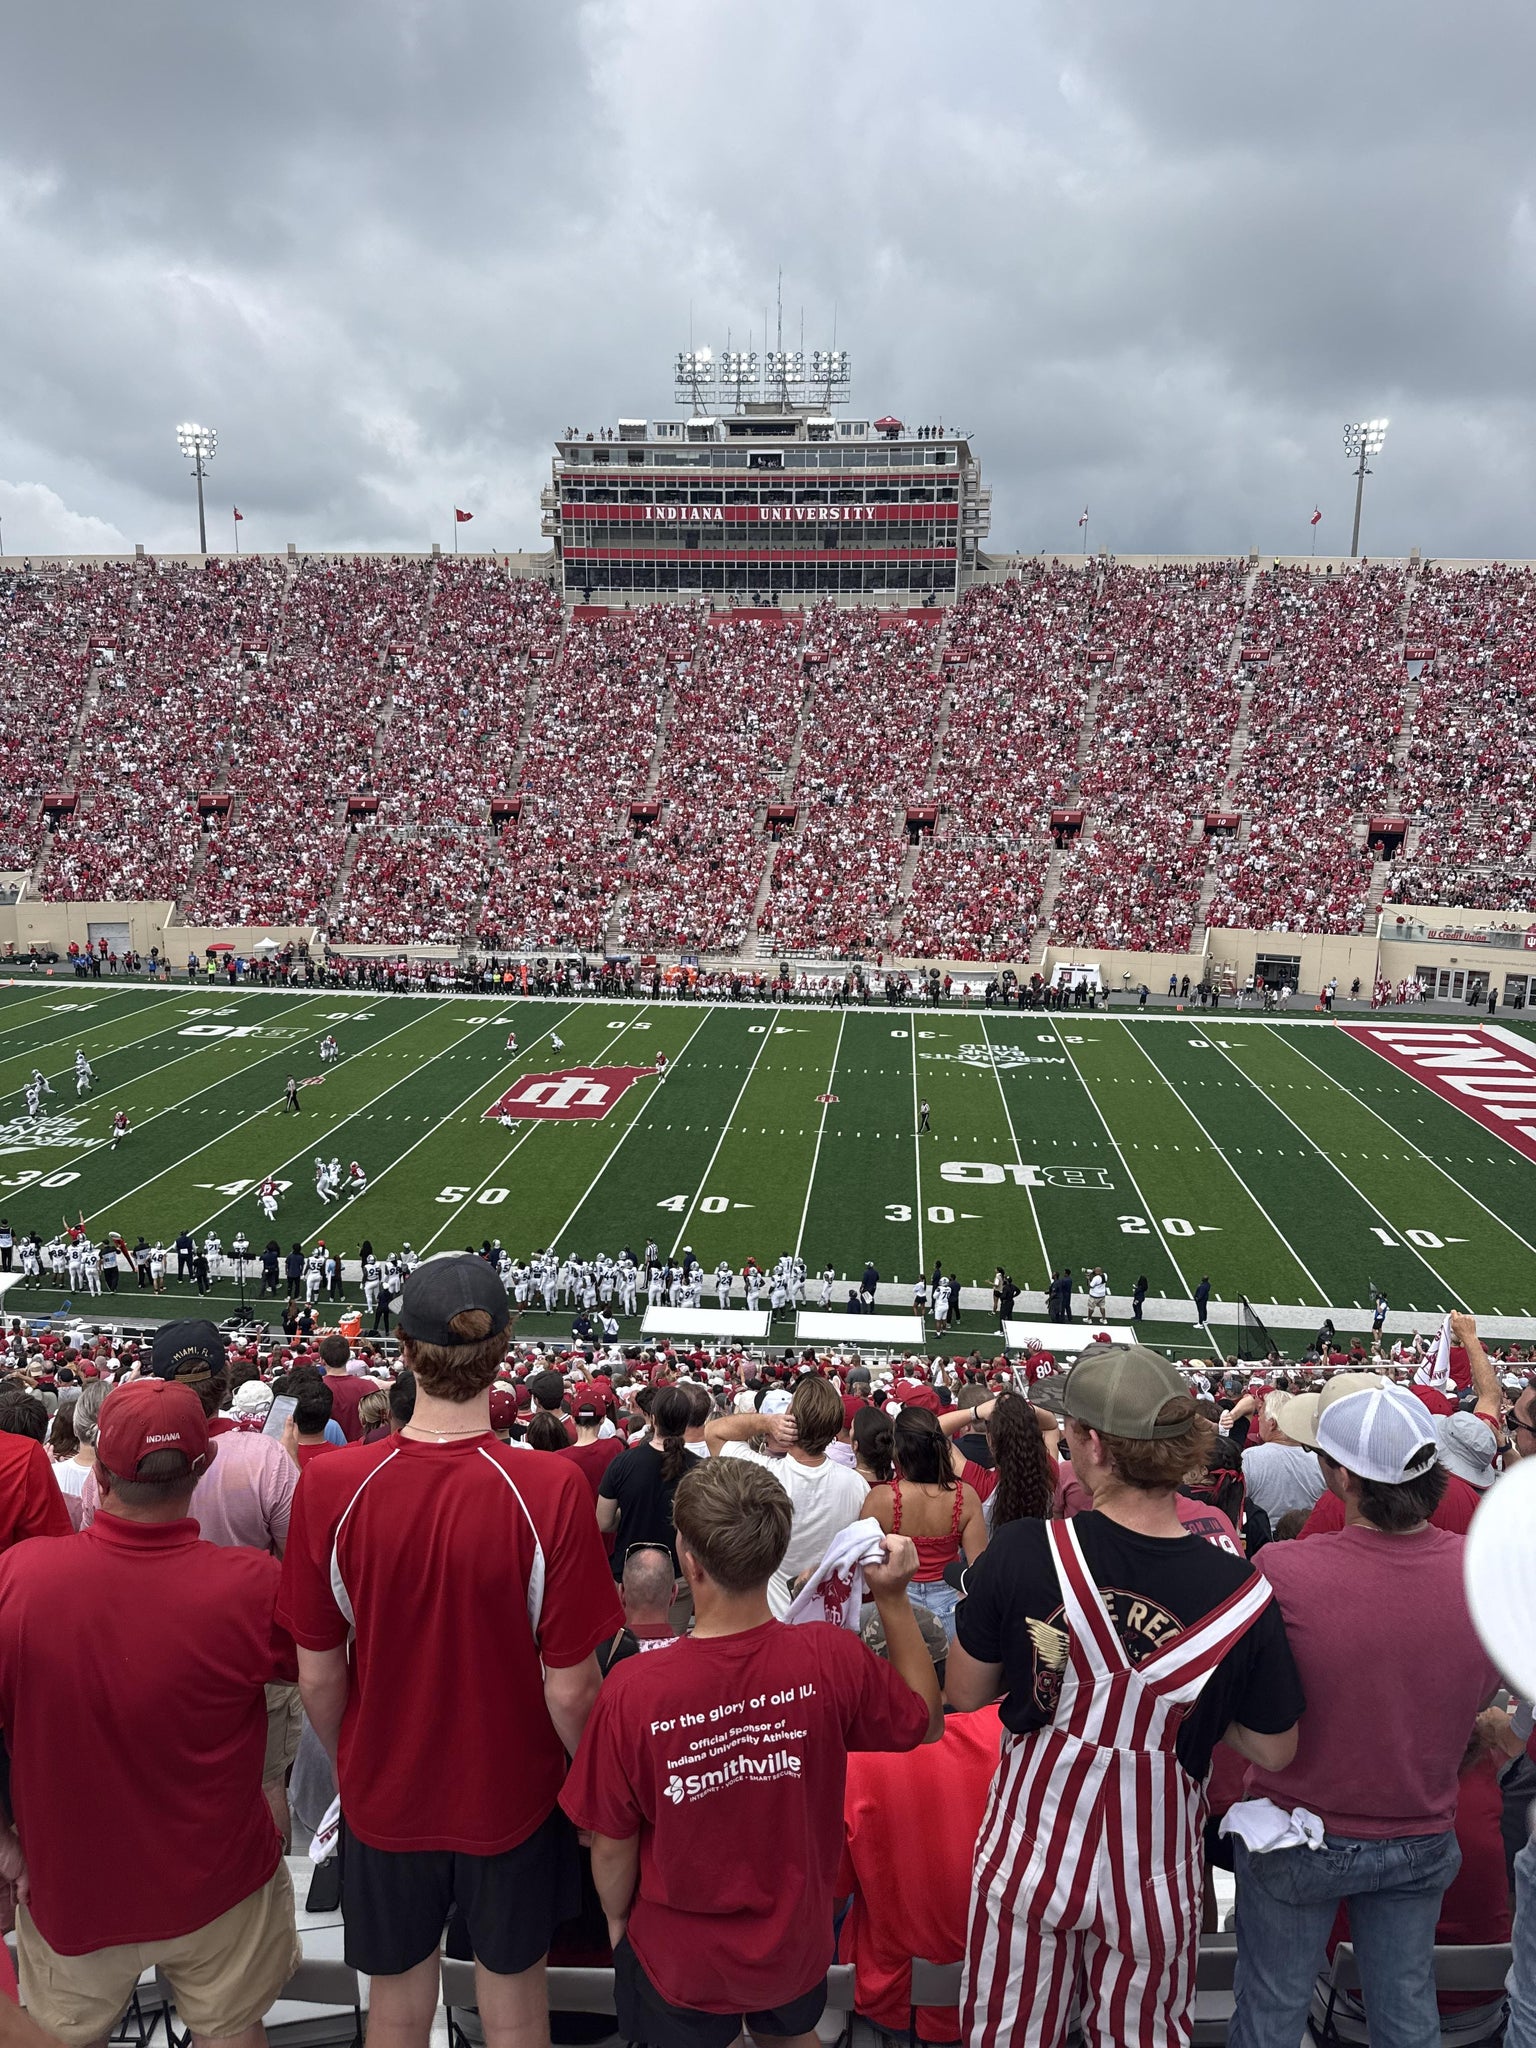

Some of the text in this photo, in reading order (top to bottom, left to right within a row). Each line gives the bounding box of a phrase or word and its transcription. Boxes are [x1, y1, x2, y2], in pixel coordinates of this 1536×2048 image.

[646, 507, 875, 520] INDIANA UNIVERSITY
[1438, 930, 1462, 940] Credit
[1464, 932, 1487, 941] Union
[0, 1170, 81, 1187] 30
[434, 1186, 510, 1205] 50
[656, 1194, 730, 1213] 40
[885, 1204, 955, 1224] 30
[1116, 1215, 1196, 1237] 20
[1369, 1226, 1445, 1249] 10
[1036, 1361, 1052, 1379] 80
[146, 1432, 180, 1443] INDIANA
[650, 1683, 817, 1736] For the glory of old IU.
[689, 1719, 786, 1751] Official Sponsor of
[667, 1728, 808, 1770] Indiana University Athletics
[690, 1786, 719, 1803] INTERNET
[725, 1775, 744, 1788] VOICE
[772, 1770, 802, 1781] SECURITY
